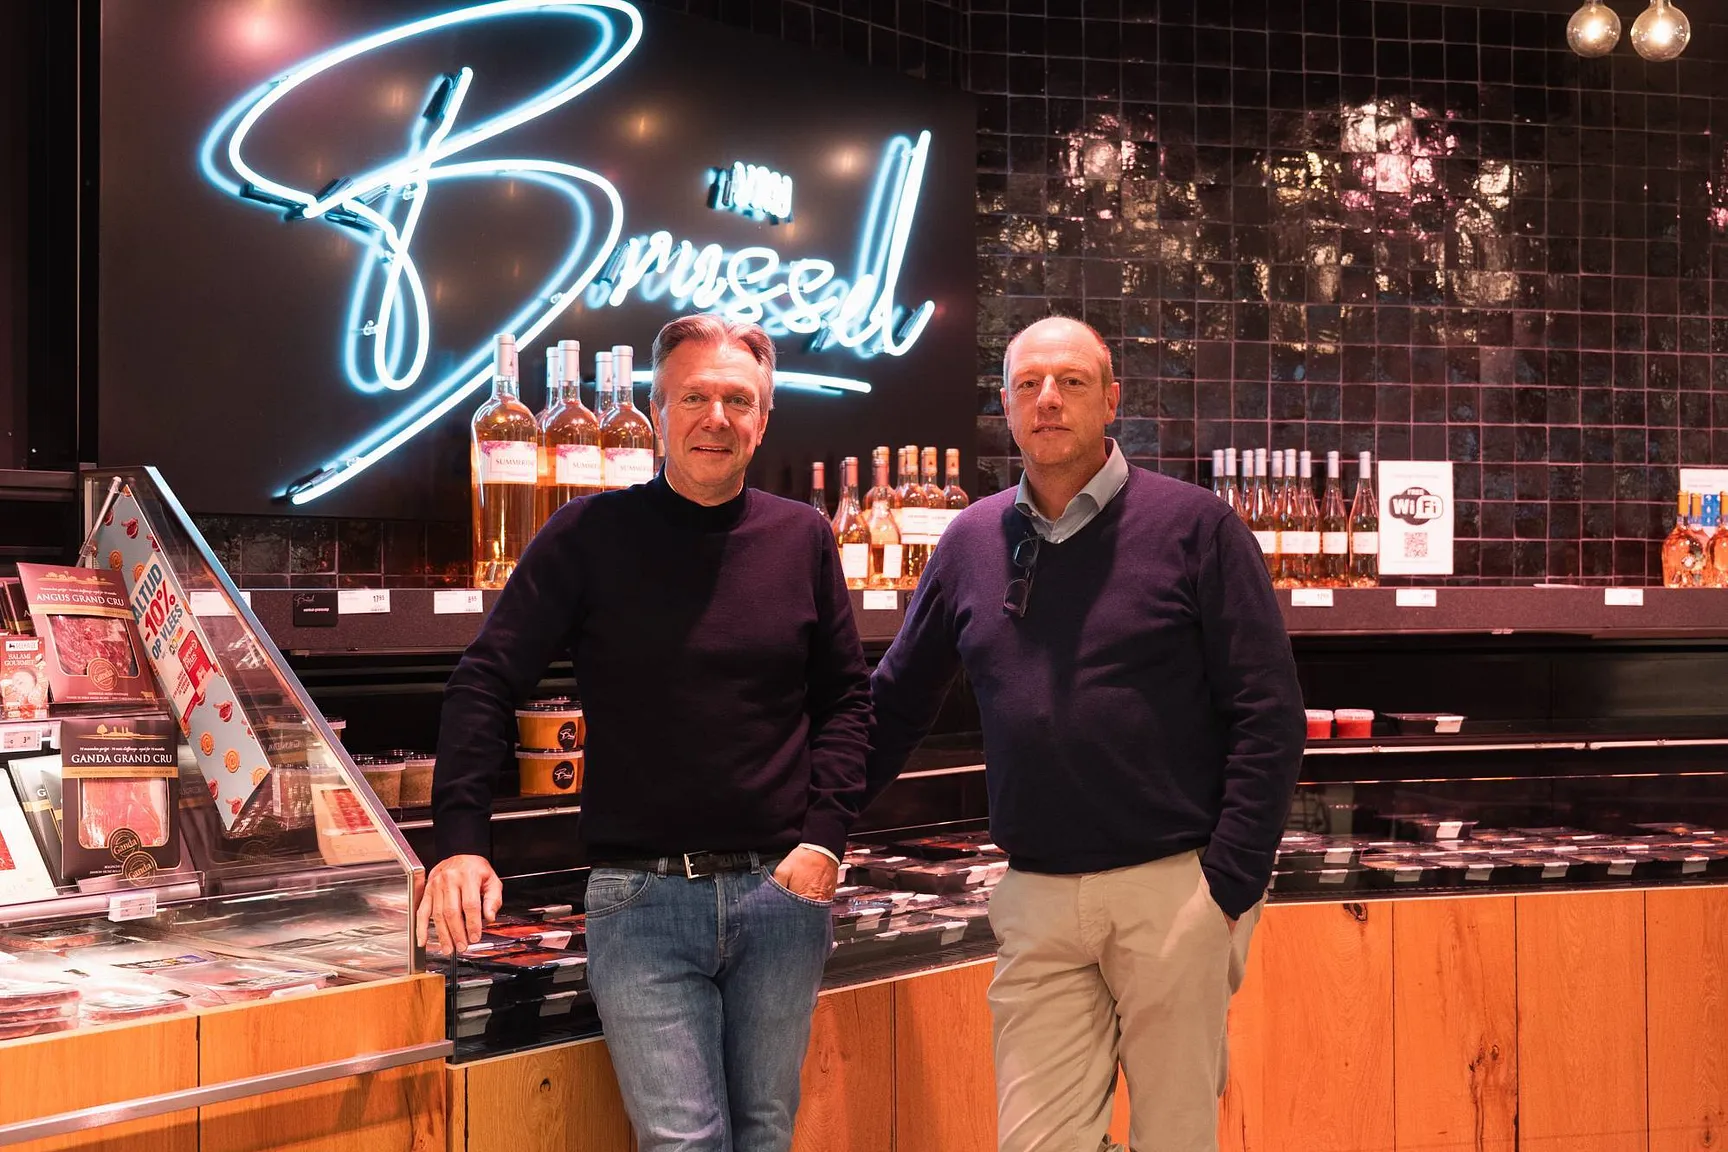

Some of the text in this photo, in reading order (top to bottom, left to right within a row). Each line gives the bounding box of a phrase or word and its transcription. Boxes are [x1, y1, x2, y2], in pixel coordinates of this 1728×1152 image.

[36, 593, 125, 607] ANGUS GRAND CRU
[131, 563, 163, 625] ALTIJD
[145, 580, 176, 642] -10%
[151, 637, 162, 661] OP
[160, 603, 183, 642] VLEES
[71, 754, 172, 763] GANDA GRAND CRU
[113, 838, 138, 855] Ganda
[128, 862, 153, 879] Ganda
